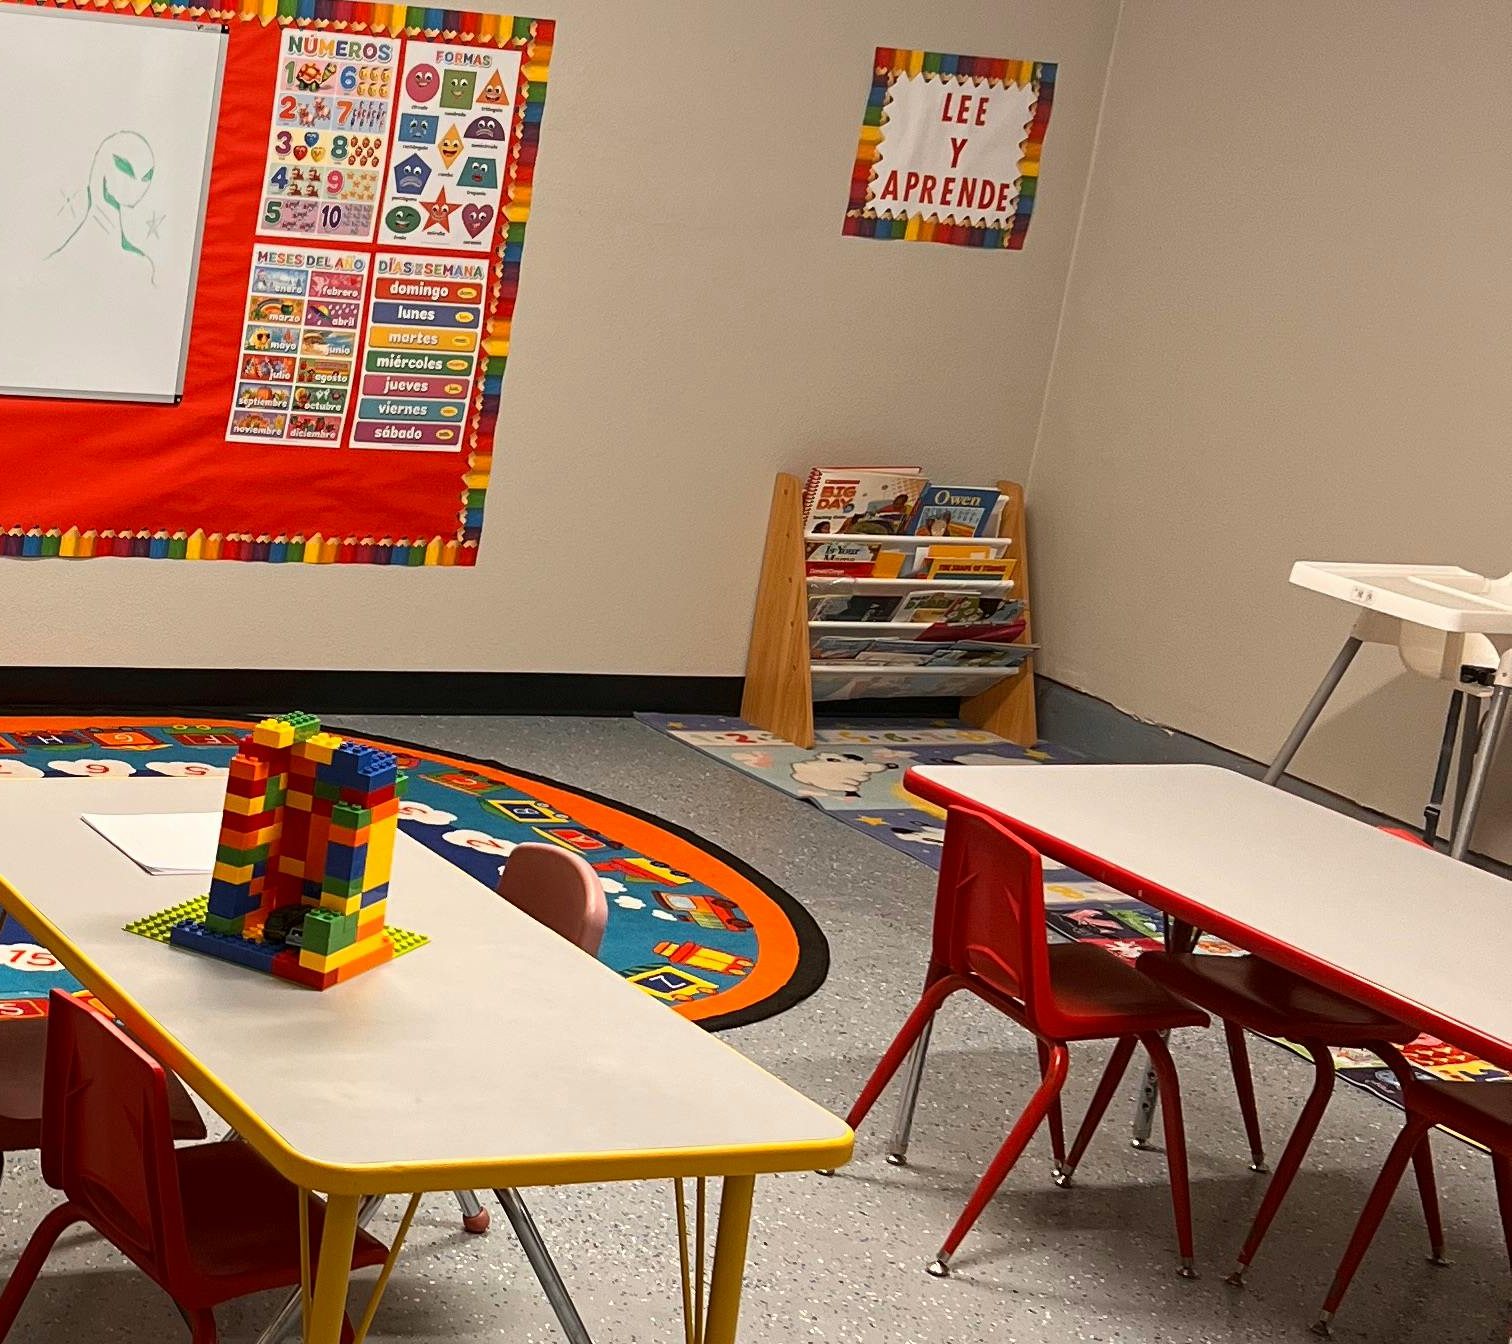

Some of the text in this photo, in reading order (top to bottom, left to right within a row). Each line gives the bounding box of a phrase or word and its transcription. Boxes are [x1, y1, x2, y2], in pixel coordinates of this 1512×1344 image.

[288, 34, 393, 63] NÚMEROS
[436, 50, 492, 68] FORMAS
[285, 61, 296, 85] 1
[340, 65, 357, 90] 6
[279, 96, 297, 120] 2
[336, 100, 353, 125] 7
[942, 93, 990, 126] LEE
[275, 130, 292, 155] 3
[331, 135, 348, 159] 8
[950, 137, 968, 168] Y
[271, 166, 288, 190] 4
[327, 170, 344, 194] 9
[880, 170, 1010, 212] APRENDE
[264, 201, 282, 224] 5
[322, 204, 342, 228] 10
[257, 251, 304, 268] MESES
[306, 256, 332, 270] DEL
[378, 256, 414, 275] DÍAS
[424, 262, 484, 280] SEMANA
[274, 284, 302, 294] enero
[322, 286, 358, 297] febrero
[390, 280, 449, 300] domingo
[269, 313, 300, 323] marzo
[331, 316, 354, 326] abril
[397, 305, 436, 320] lunes
[389, 331, 438, 344] martes
[270, 341, 296, 352] mayo
[376, 353, 443, 370] miércoles
[269, 368, 291, 381] julio
[314, 373, 348, 384] agosto
[384, 376, 428, 394] jueves
[238, 397, 288, 408] septiembre
[304, 402, 342, 411] octubre
[378, 401, 428, 415] viernes
[233, 425, 282, 436] noviembre
[290, 428, 336, 439] diciembre
[374, 426, 422, 440] sábado
[820, 485, 857, 499] BIG
[934, 489, 981, 506] Owen
[816, 498, 852, 511] DAY
[38, 735, 64, 745] H
[115, 734, 134, 744] G
[9, 949, 57, 967] 15
